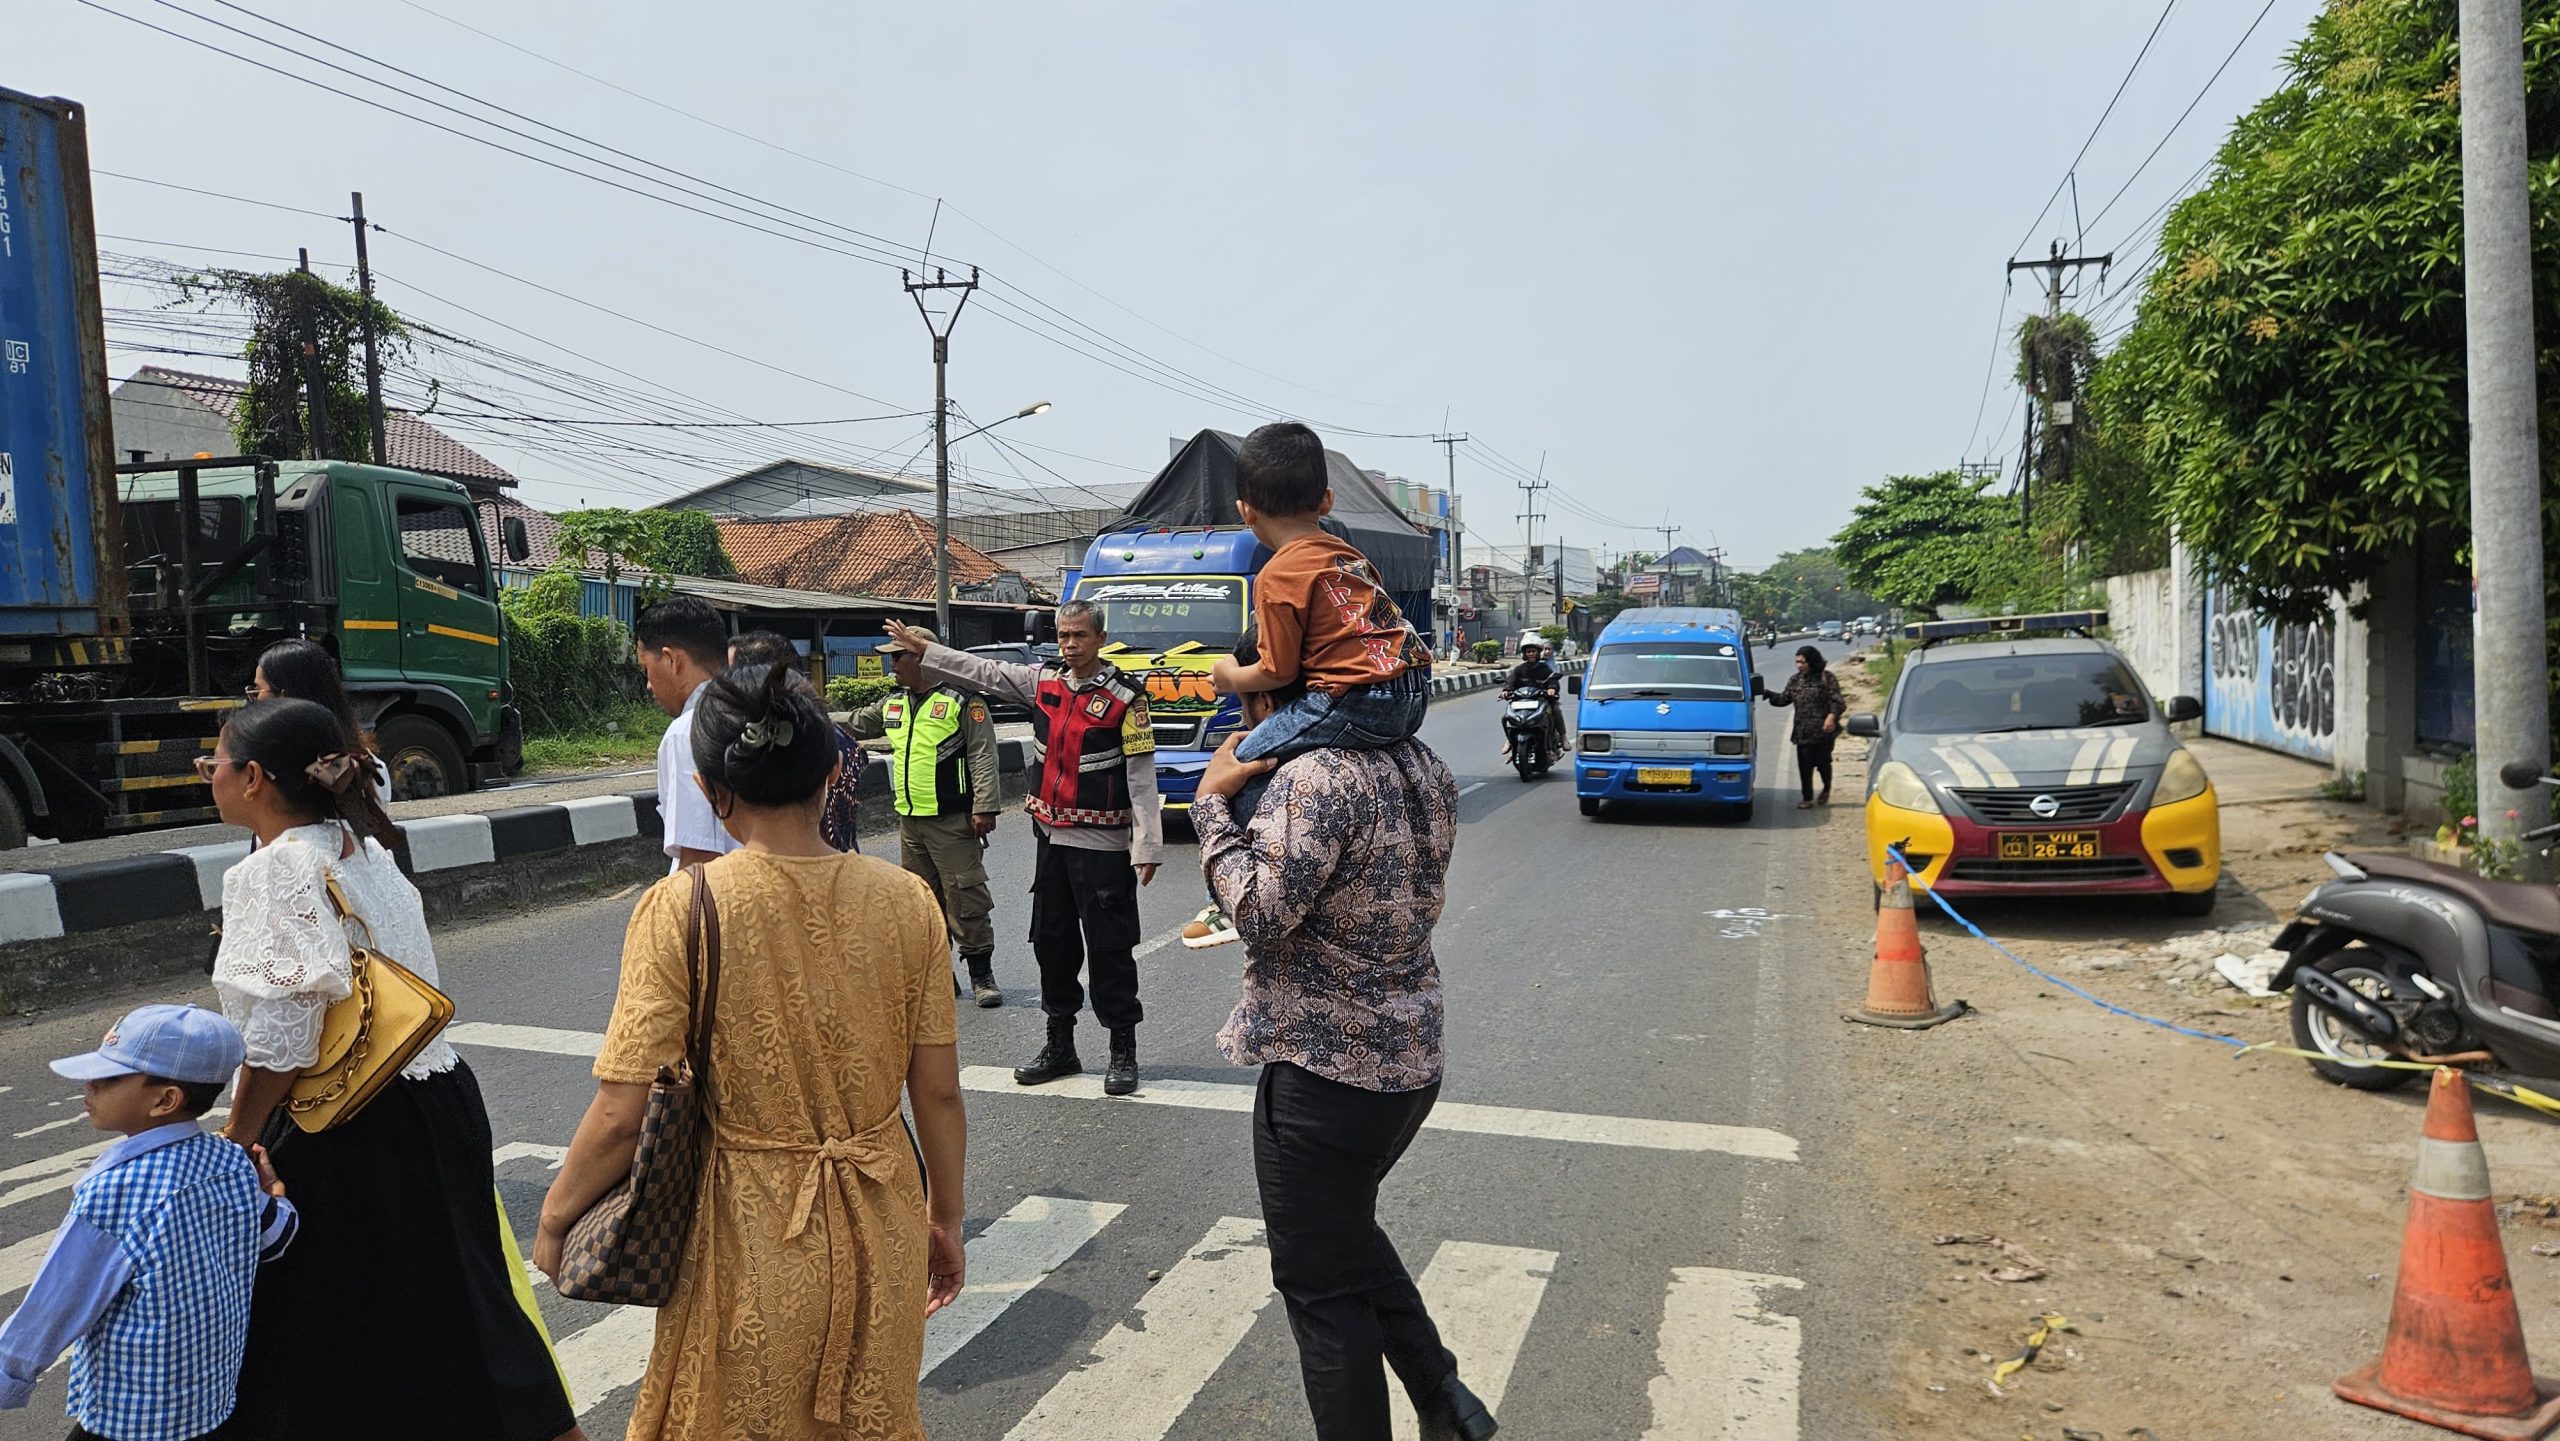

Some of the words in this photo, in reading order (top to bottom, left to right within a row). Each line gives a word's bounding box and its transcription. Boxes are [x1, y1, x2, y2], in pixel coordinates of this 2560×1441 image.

[10, 361, 26, 374] 81
[1937, 729, 2129, 747] POLISI
[2049, 832, 2079, 844] VIII
